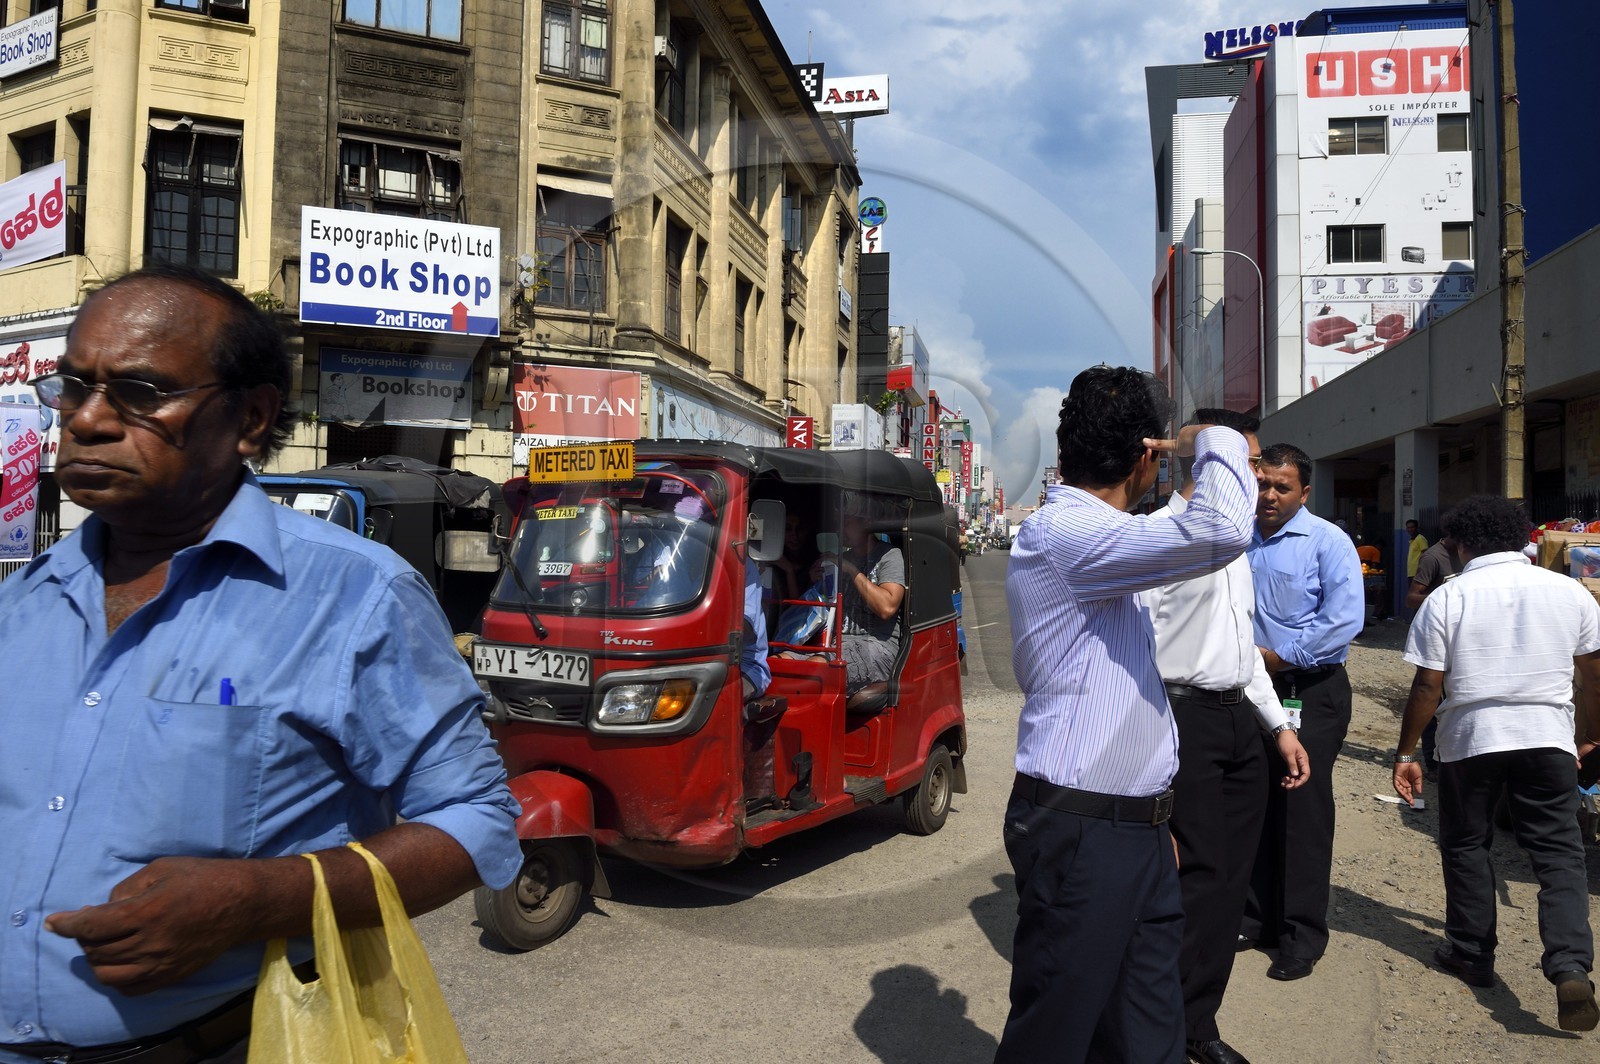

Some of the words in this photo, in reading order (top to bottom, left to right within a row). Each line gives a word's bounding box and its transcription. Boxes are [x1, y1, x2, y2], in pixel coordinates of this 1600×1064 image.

[0, 38, 24, 65] Book
[27, 31, 52, 55] Shop
[1369, 103, 1395, 112] SOLE
[1402, 101, 1458, 110] IMPORTER
[310, 219, 419, 251] Expographic
[424, 228, 462, 257] (Pvt)
[309, 251, 400, 291] Book
[409, 261, 492, 306] Shop
[375, 310, 404, 327] 2nd
[408, 313, 448, 330] Floor
[340, 354, 407, 368] Expographic
[409, 359, 434, 371] (Pvt)
[435, 361, 455, 372] Ltd.
[362, 376, 466, 402] Bookshop
[541, 392, 636, 417] TITAN
[513, 437, 551, 447] FAIZAL
[4, 453, 40, 486] 20%
[534, 449, 596, 473] METERED
[599, 447, 629, 471] TAXI
[604, 636, 654, 647] KING
